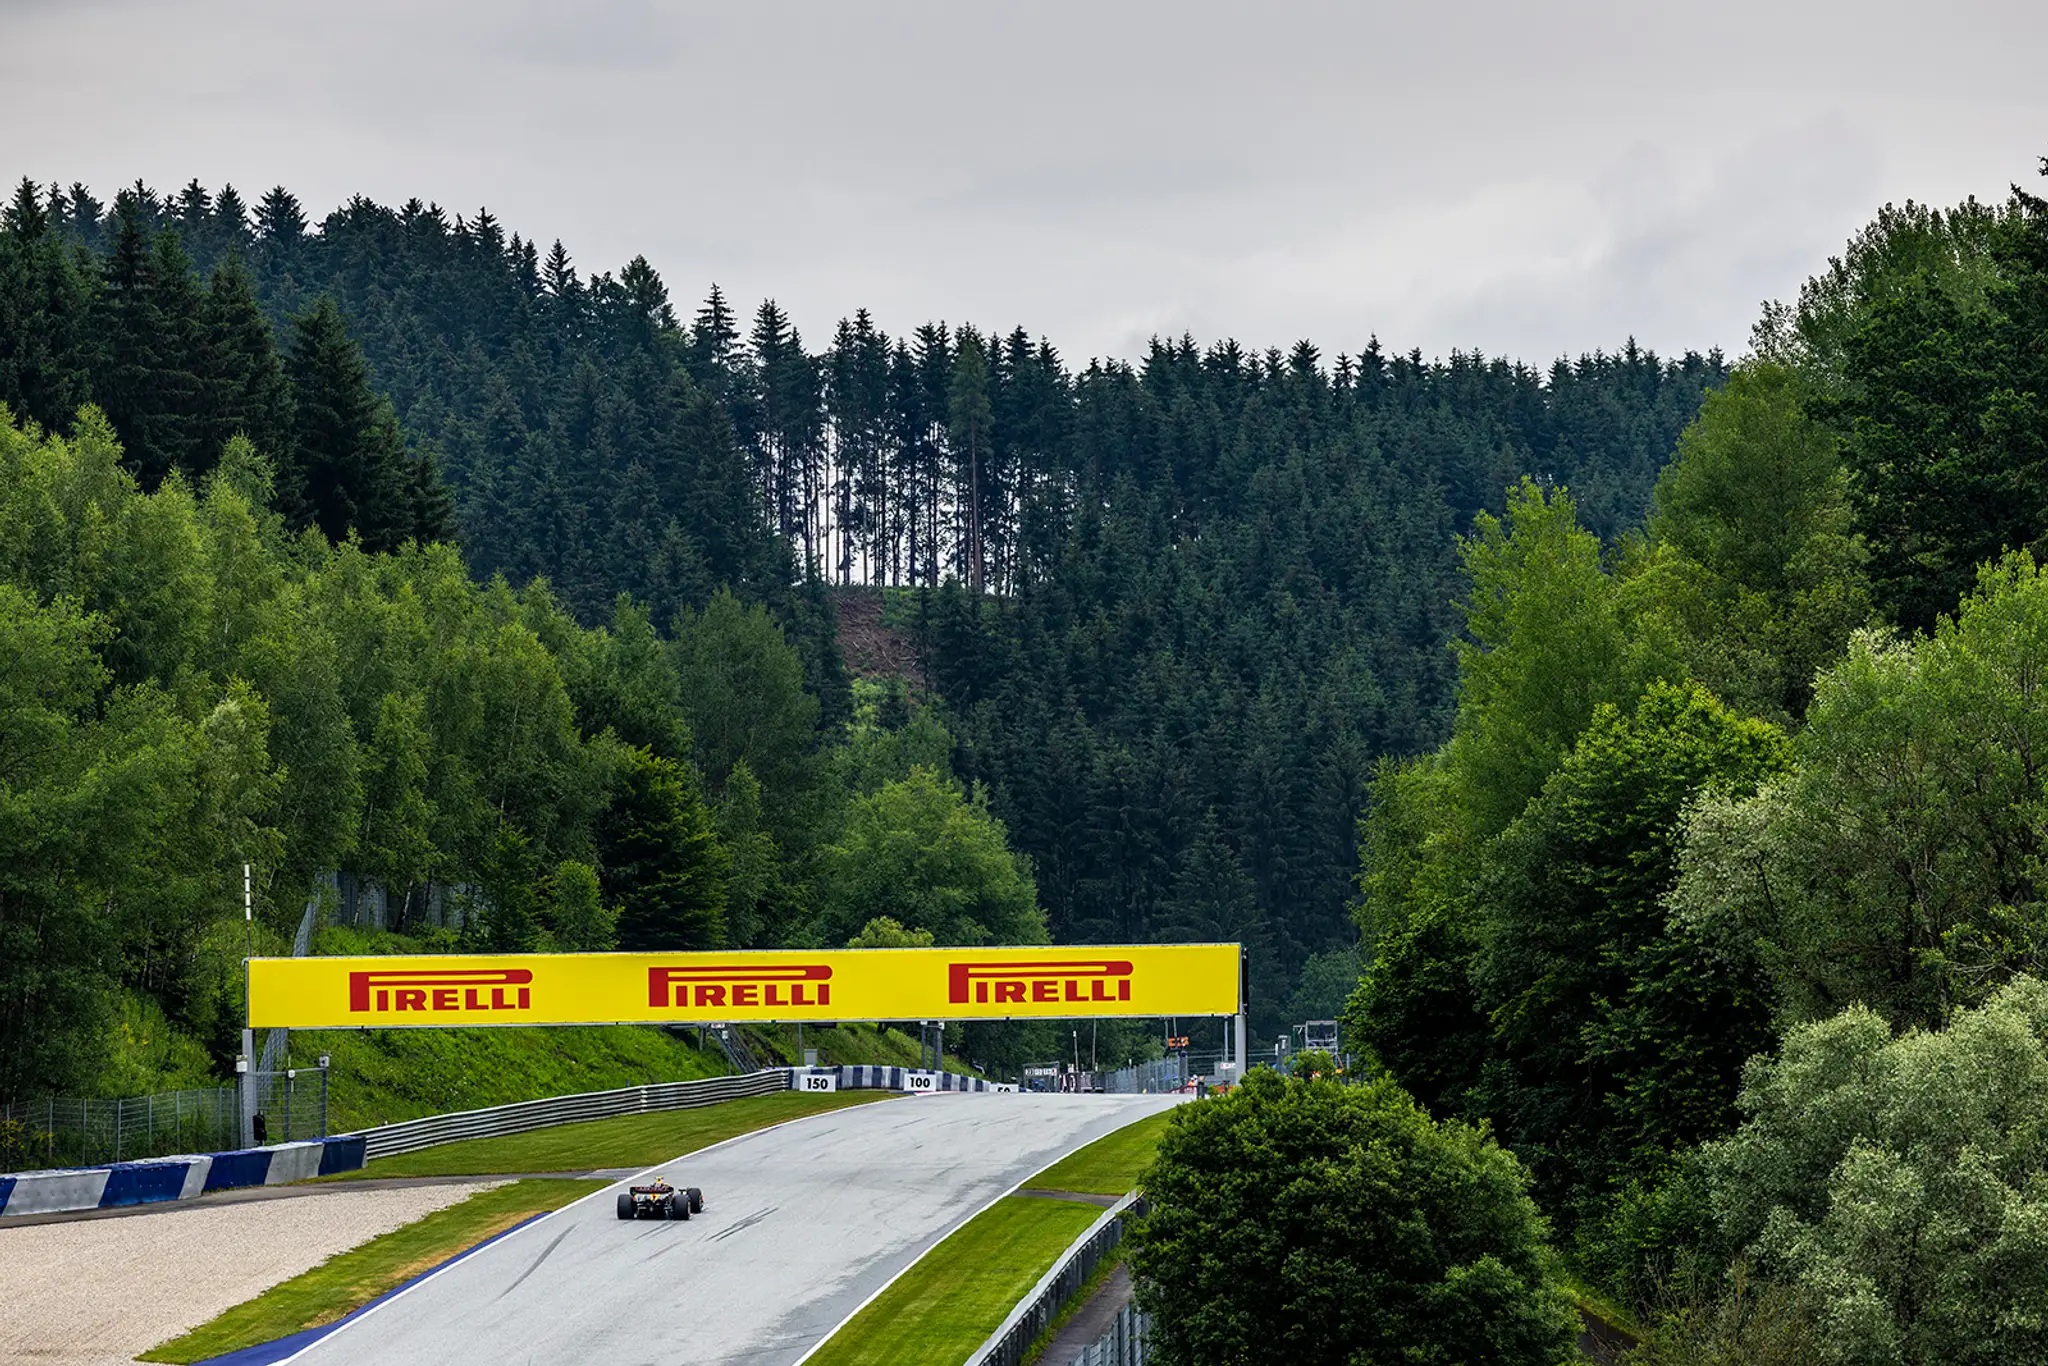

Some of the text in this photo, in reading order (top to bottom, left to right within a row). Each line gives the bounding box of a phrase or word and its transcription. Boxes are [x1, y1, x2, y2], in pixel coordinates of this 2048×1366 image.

[349, 969, 533, 1012] PIRELLI
[649, 965, 832, 1008] PIRELLI
[949, 961, 1134, 1004] PIRELLI
[806, 1077, 829, 1090] 150
[909, 1076, 931, 1089] 100
